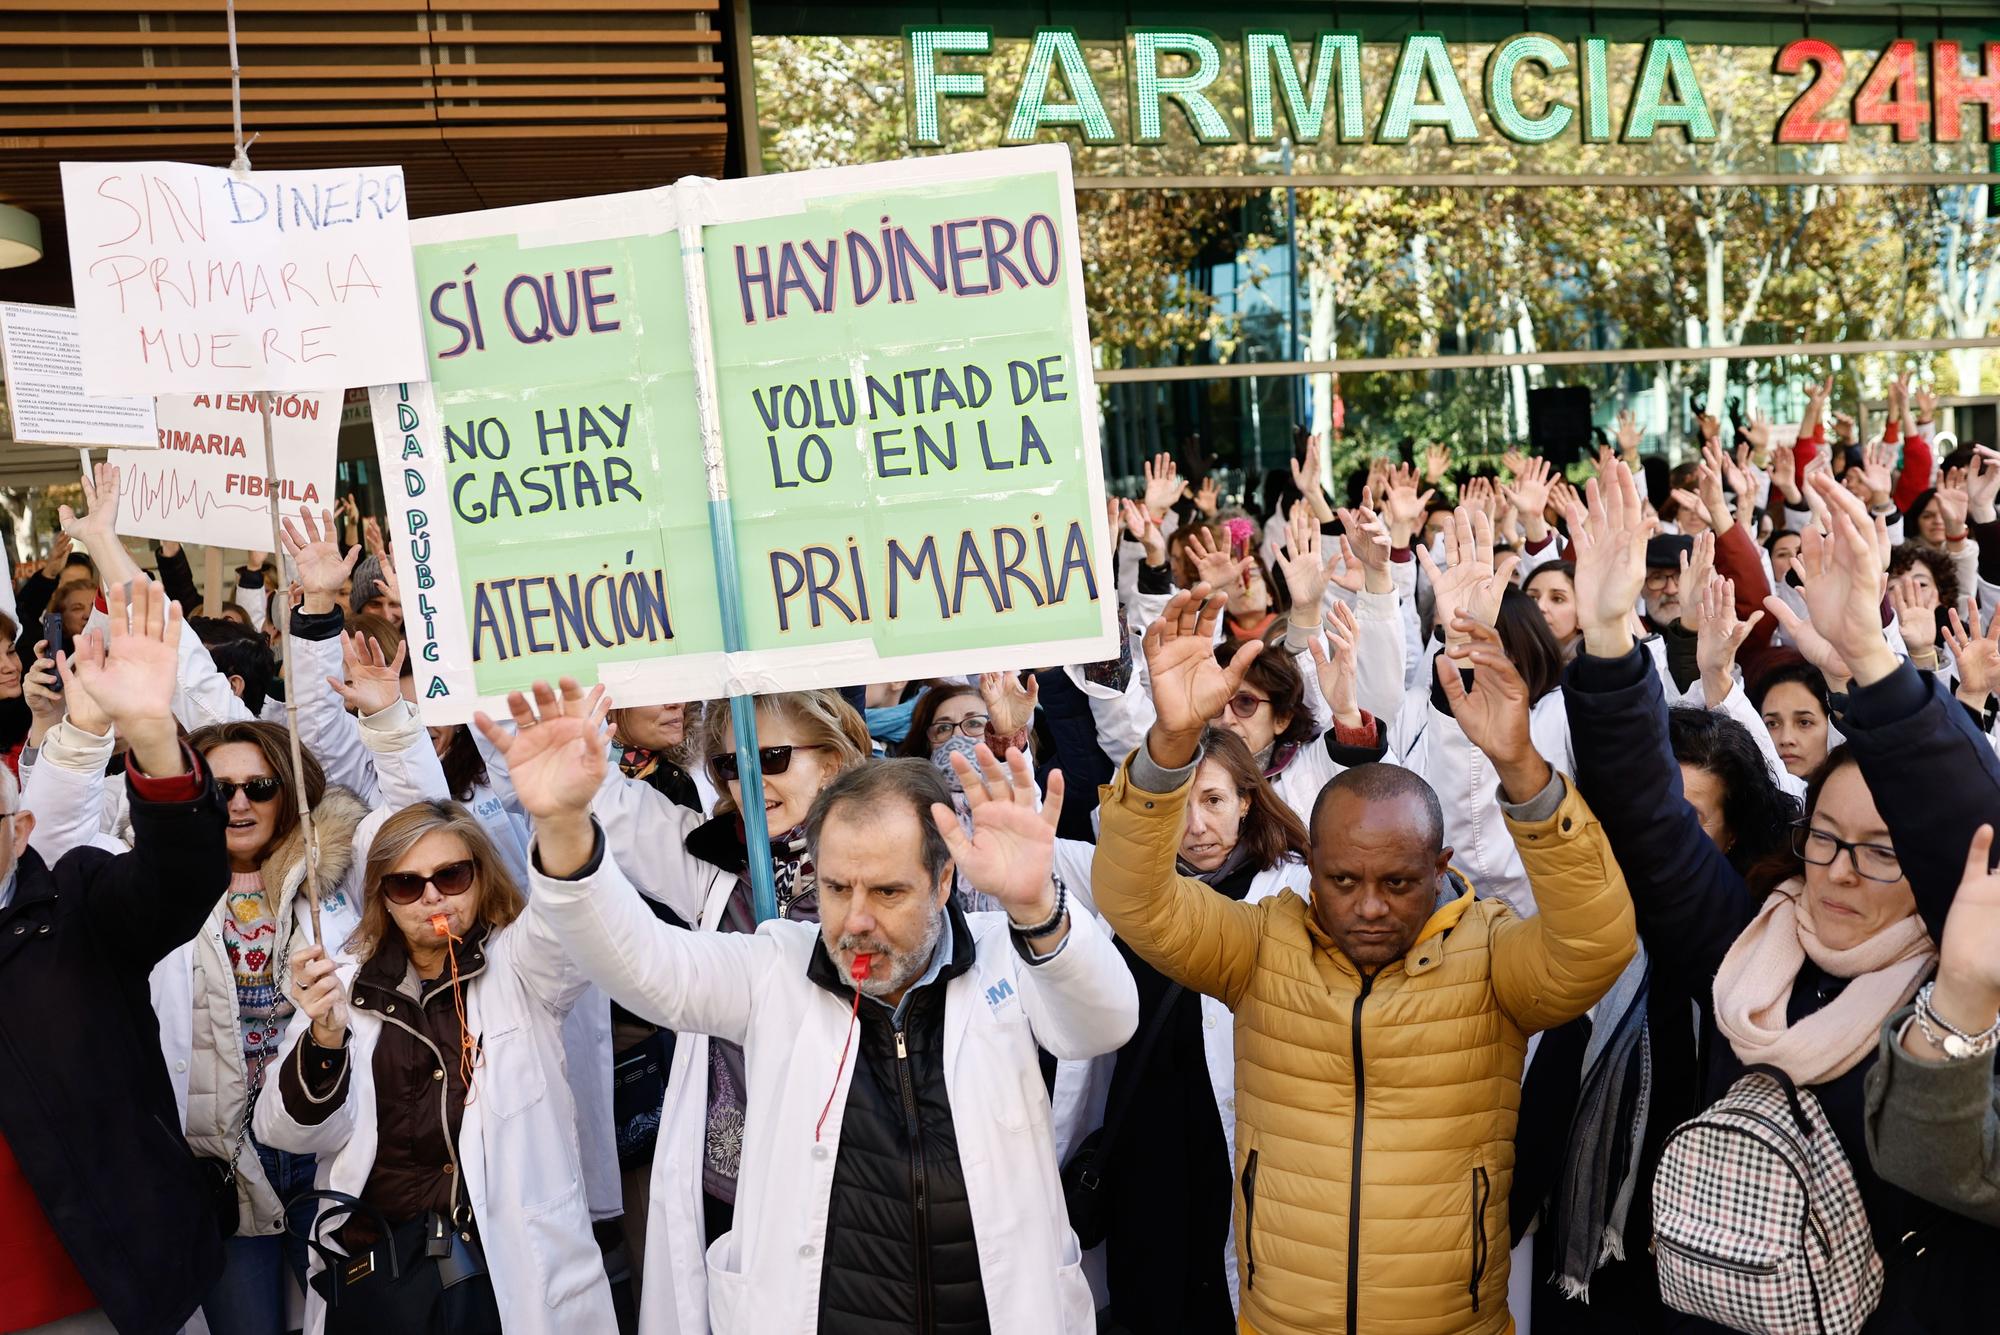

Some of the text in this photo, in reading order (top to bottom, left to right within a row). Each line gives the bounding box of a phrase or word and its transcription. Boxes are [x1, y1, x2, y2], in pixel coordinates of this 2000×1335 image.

[904, 26, 2000, 143] FARMACIA 24H
[97, 172, 404, 248] SIN DINERO
[89, 254, 383, 314] PRIMARIA
[429, 213, 1063, 360] SÍ QUE HAY DINERO
[139, 325, 338, 374] MUERE
[444, 354, 1069, 465] NO HAY VOLUNTAD DE
[453, 414, 1053, 526] GASTAR LO EN LA
[472, 550, 675, 664] ATENCIÓN
